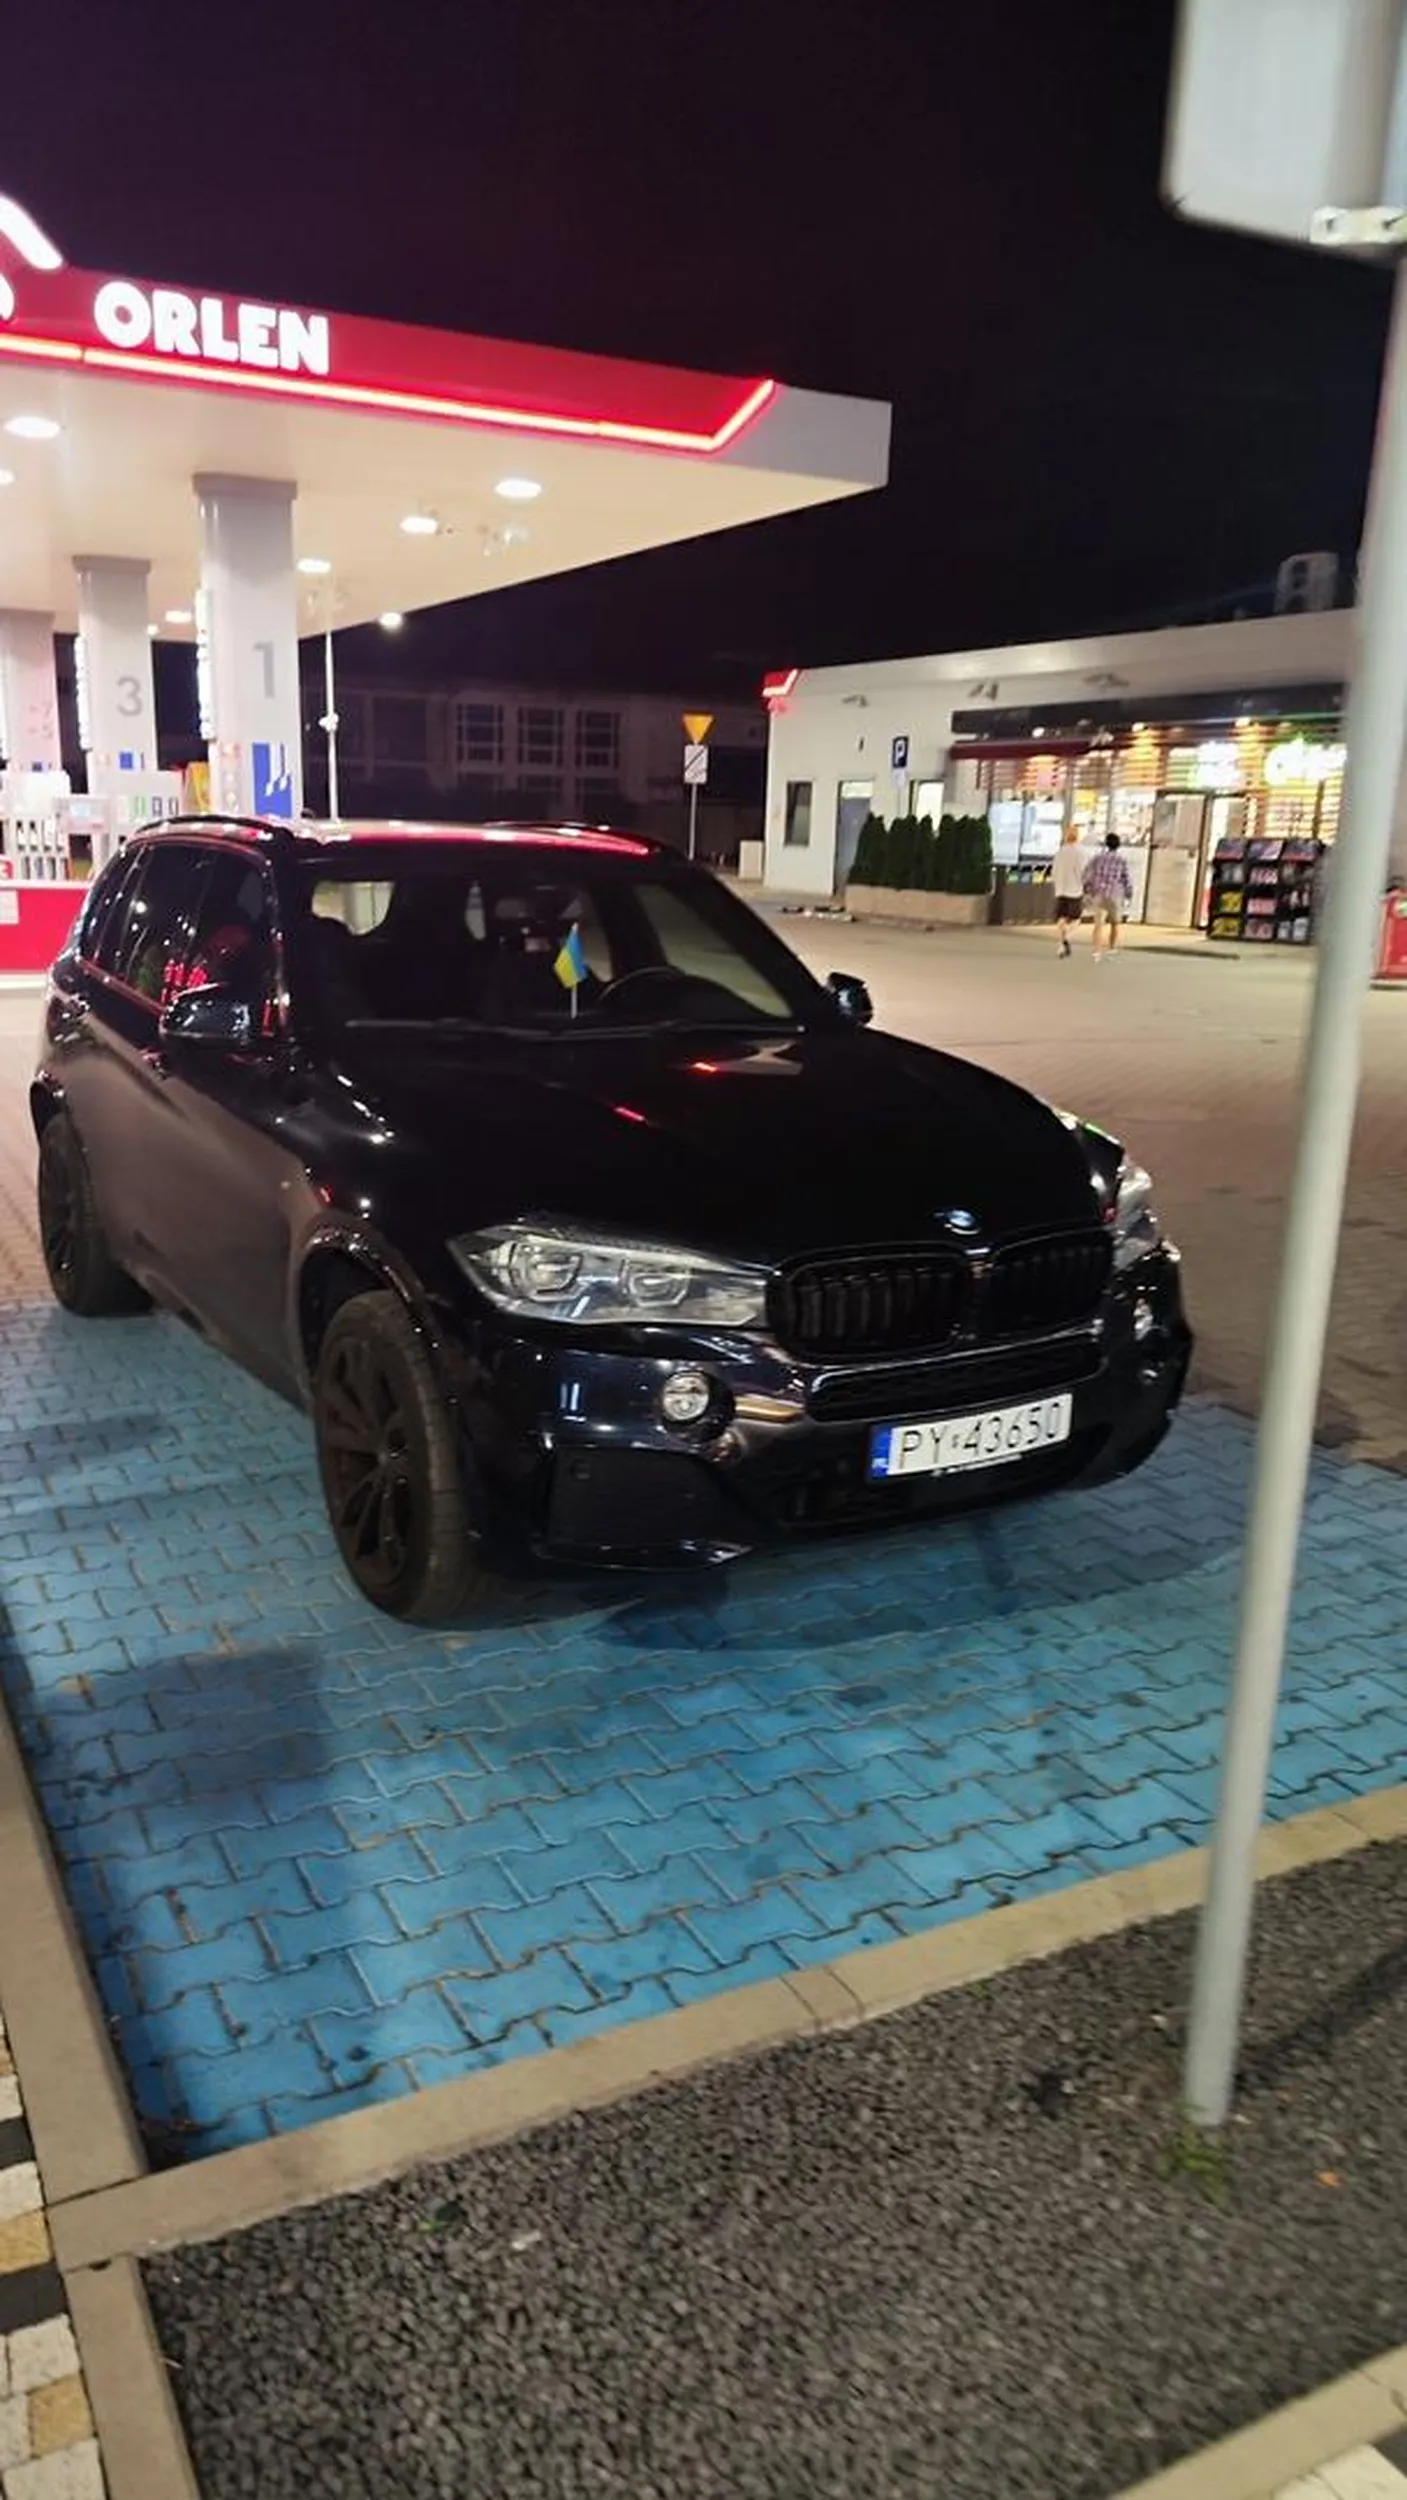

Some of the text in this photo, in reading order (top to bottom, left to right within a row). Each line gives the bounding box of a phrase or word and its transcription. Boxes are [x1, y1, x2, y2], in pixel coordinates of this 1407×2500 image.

[94, 281, 330, 376] ORLEN
[116, 676, 143, 717] 3
[253, 641, 276, 699] 1
[901, 1424, 949, 1470] PY
[963, 1402, 1063, 1457] 43650
